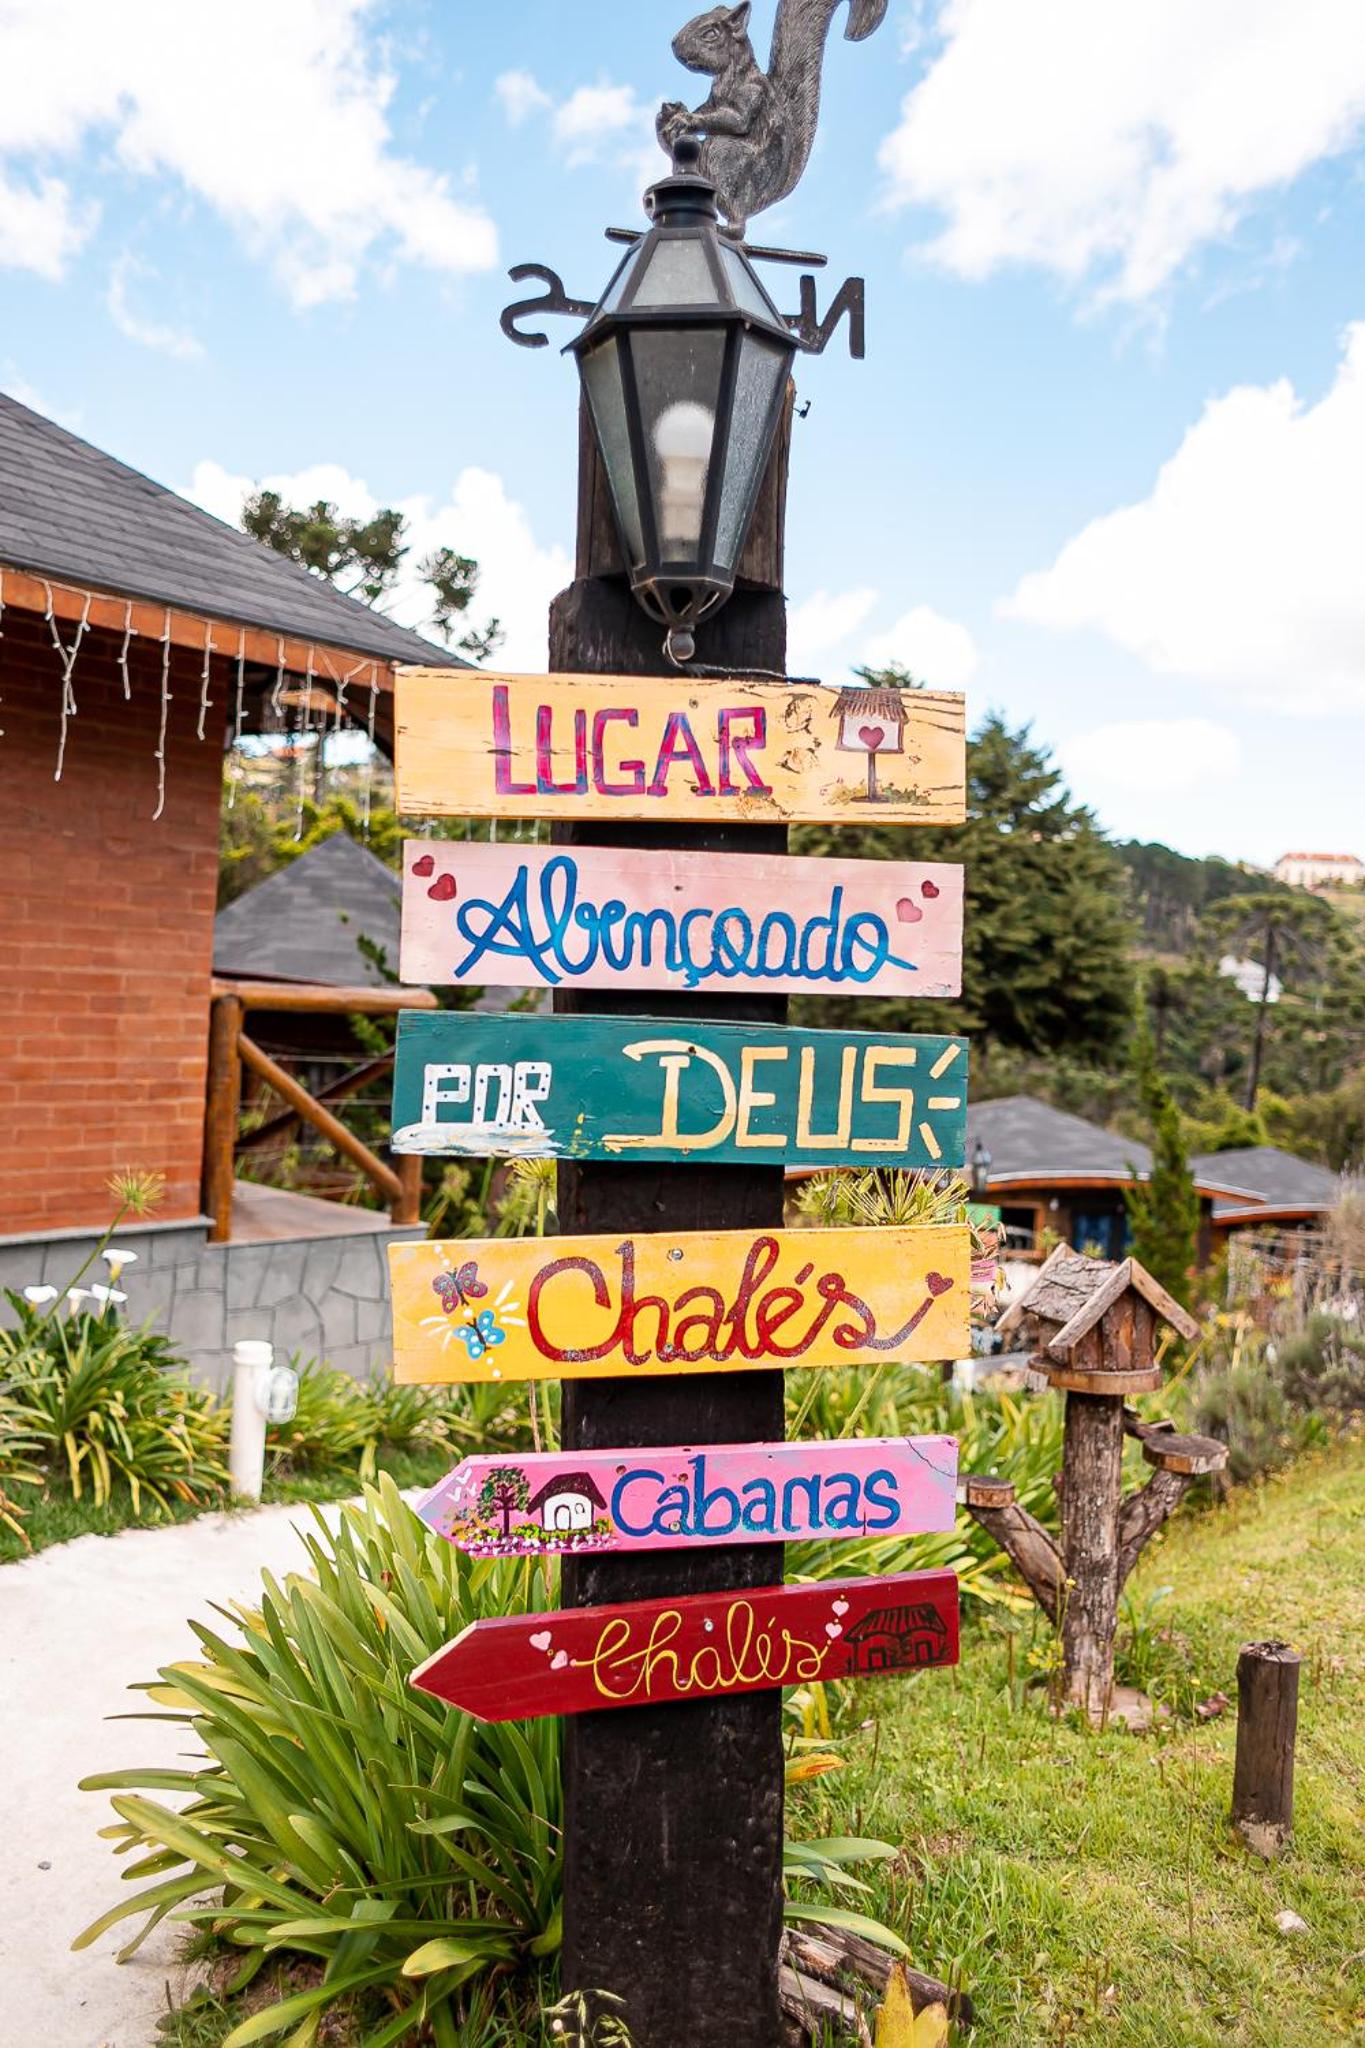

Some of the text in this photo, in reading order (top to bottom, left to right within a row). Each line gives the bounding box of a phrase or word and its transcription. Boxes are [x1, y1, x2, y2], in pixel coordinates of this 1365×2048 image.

[492, 684, 774, 797] LUGAR
[421, 1039, 917, 1153] POR DEUS
[526, 1235, 934, 1366] Chalés
[610, 1455, 902, 1538] Cabanas
[571, 1600, 832, 1698] Chalés
